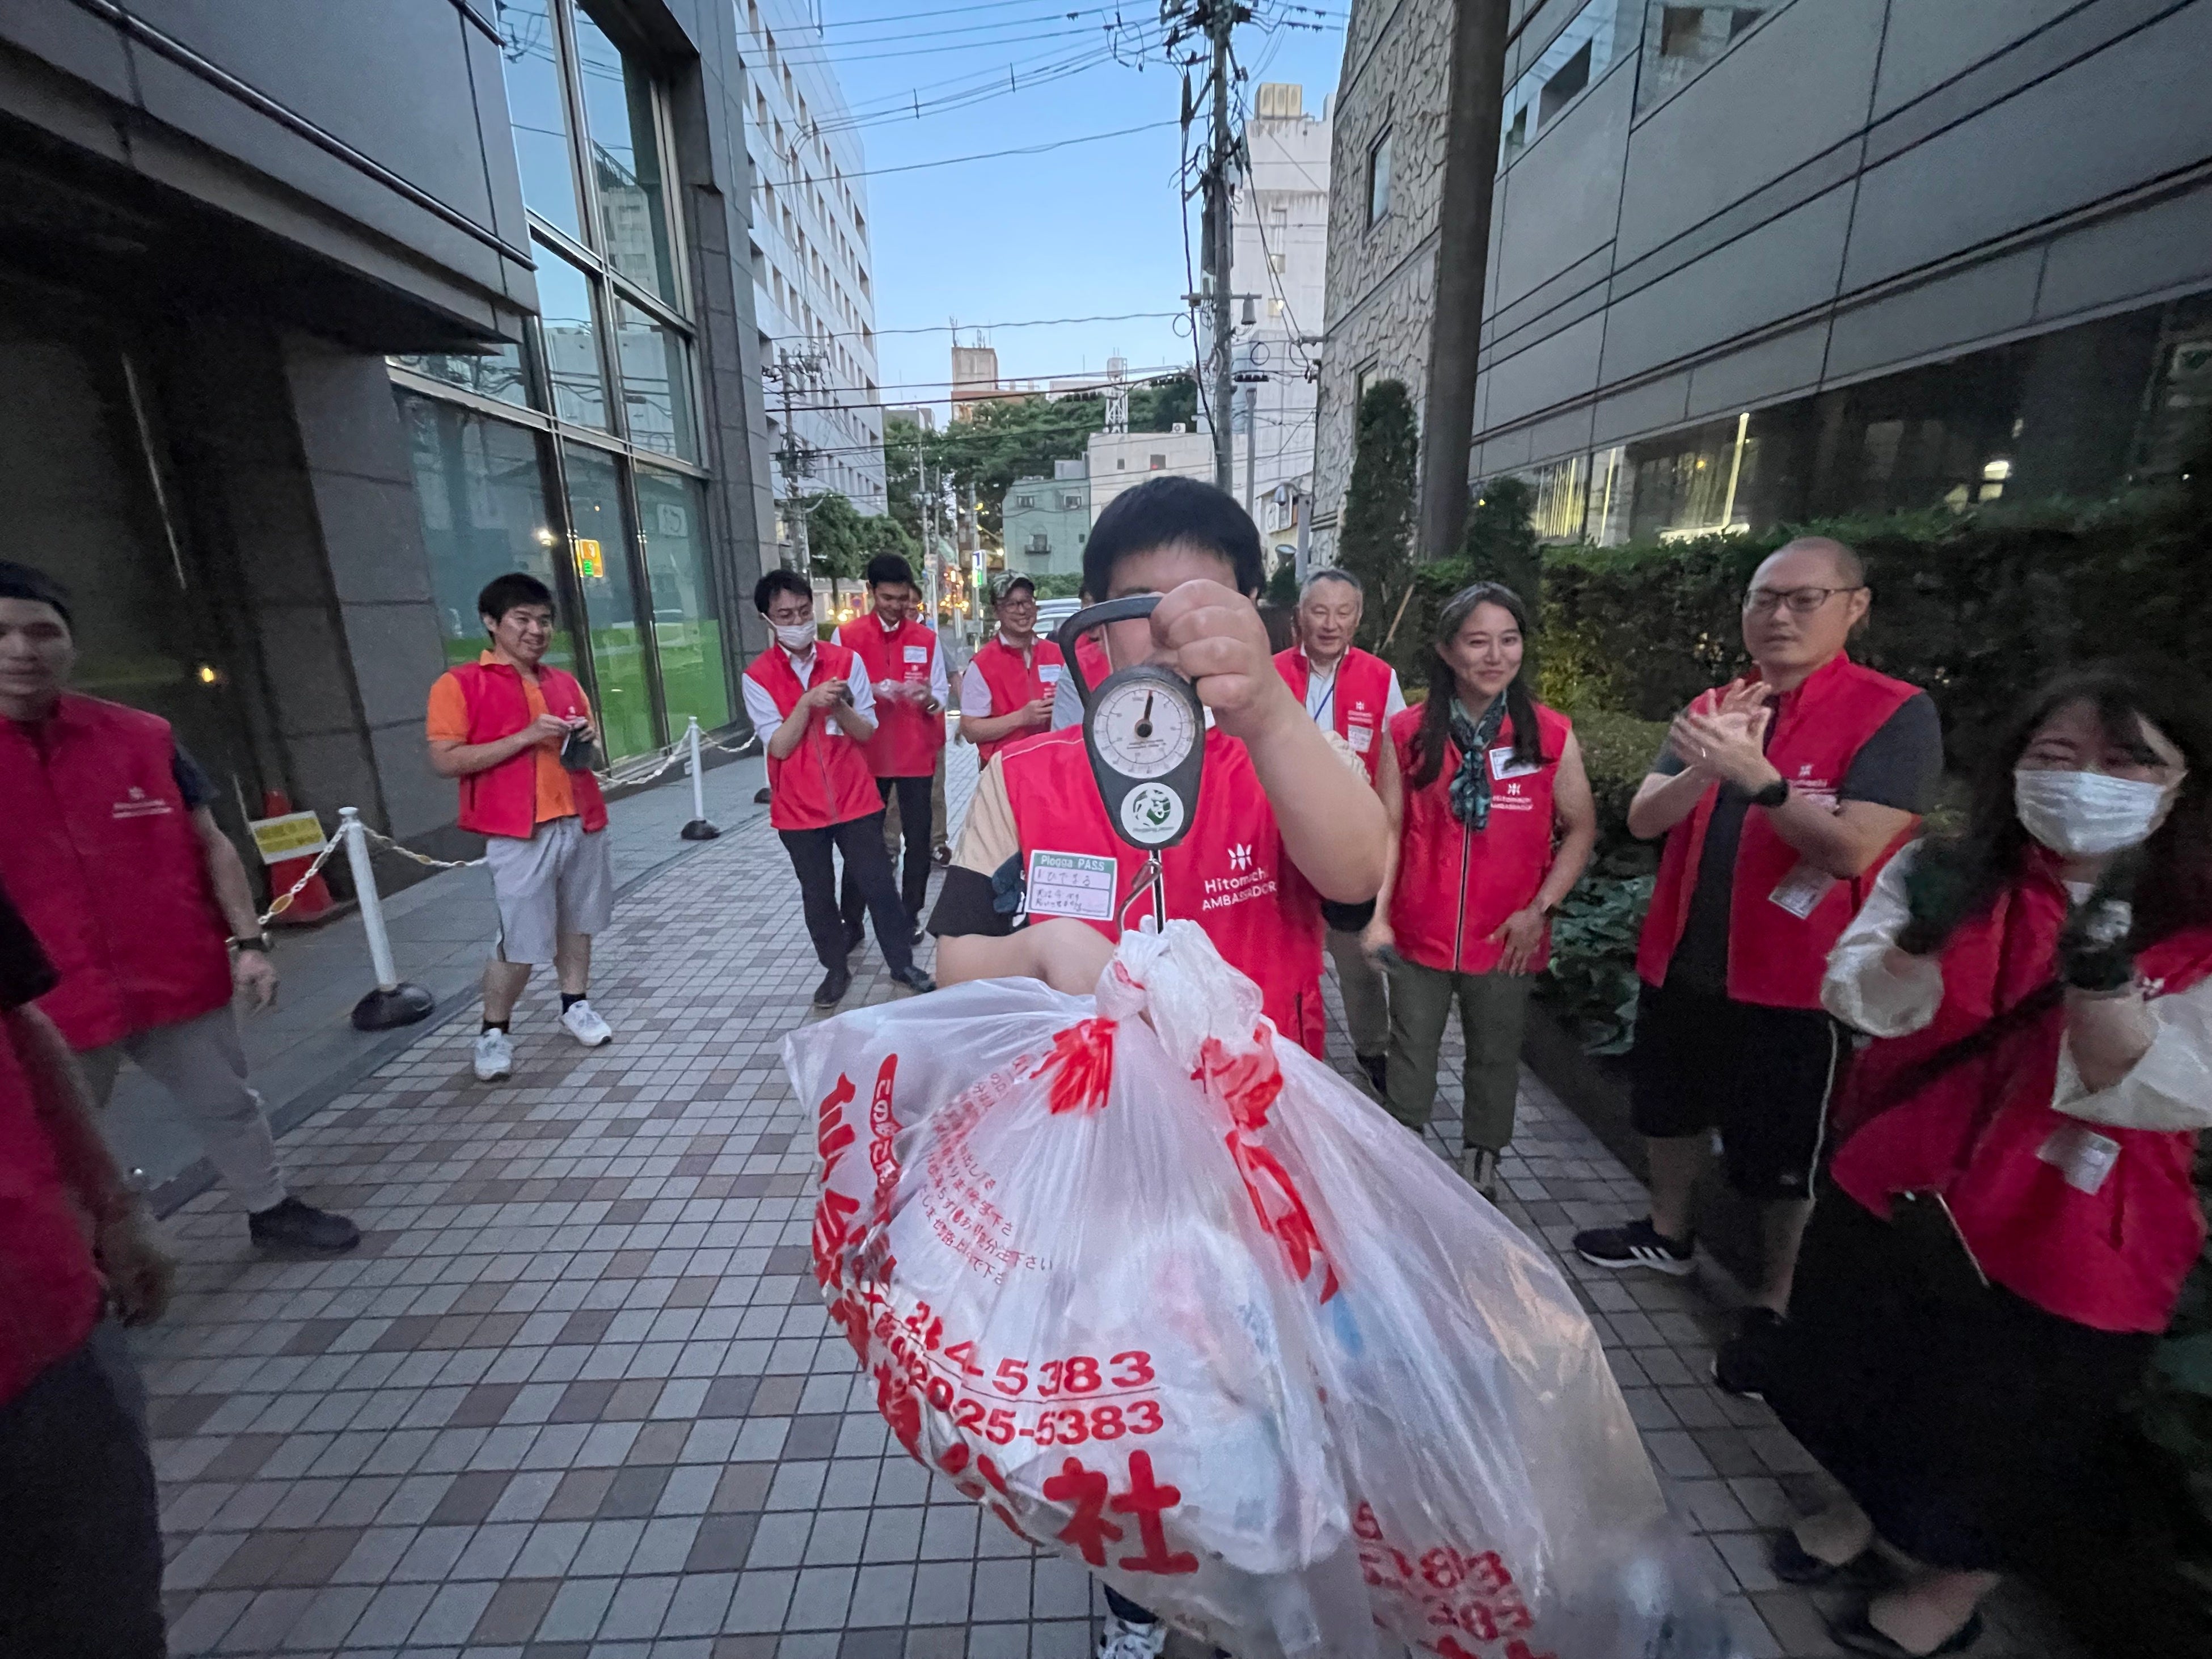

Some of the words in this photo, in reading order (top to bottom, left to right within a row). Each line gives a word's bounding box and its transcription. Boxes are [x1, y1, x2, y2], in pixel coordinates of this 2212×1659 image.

[1078, 858, 1105, 872] PASS
[1204, 864, 1269, 894] Hitomch
[1042, 1450, 1199, 1574] 社
